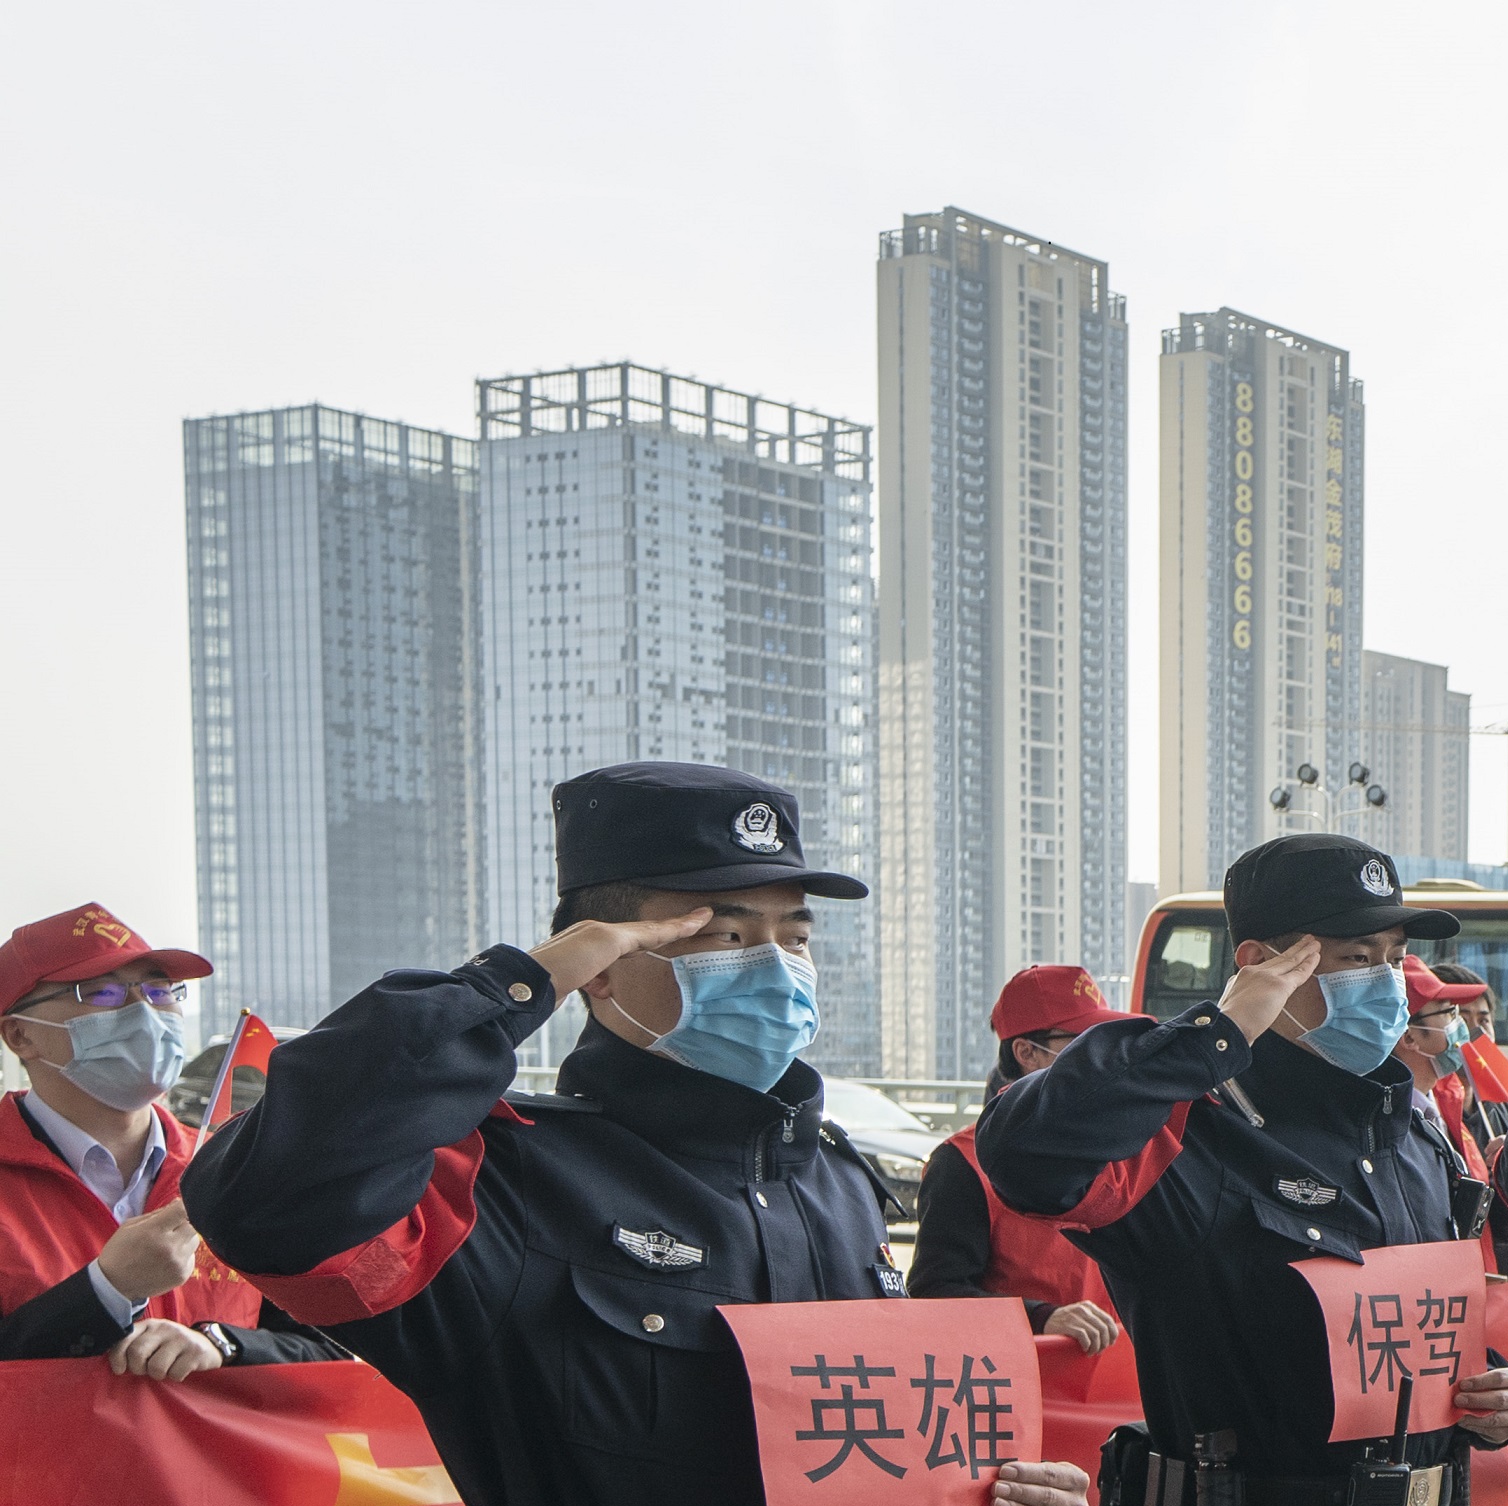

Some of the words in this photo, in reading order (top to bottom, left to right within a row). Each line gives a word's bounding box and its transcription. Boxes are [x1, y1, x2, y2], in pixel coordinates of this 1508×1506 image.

[1233, 382, 1254, 650] 88086666
[1347, 1289, 1468, 1394] 保驾
[790, 1354, 1018, 1484] 英雄
